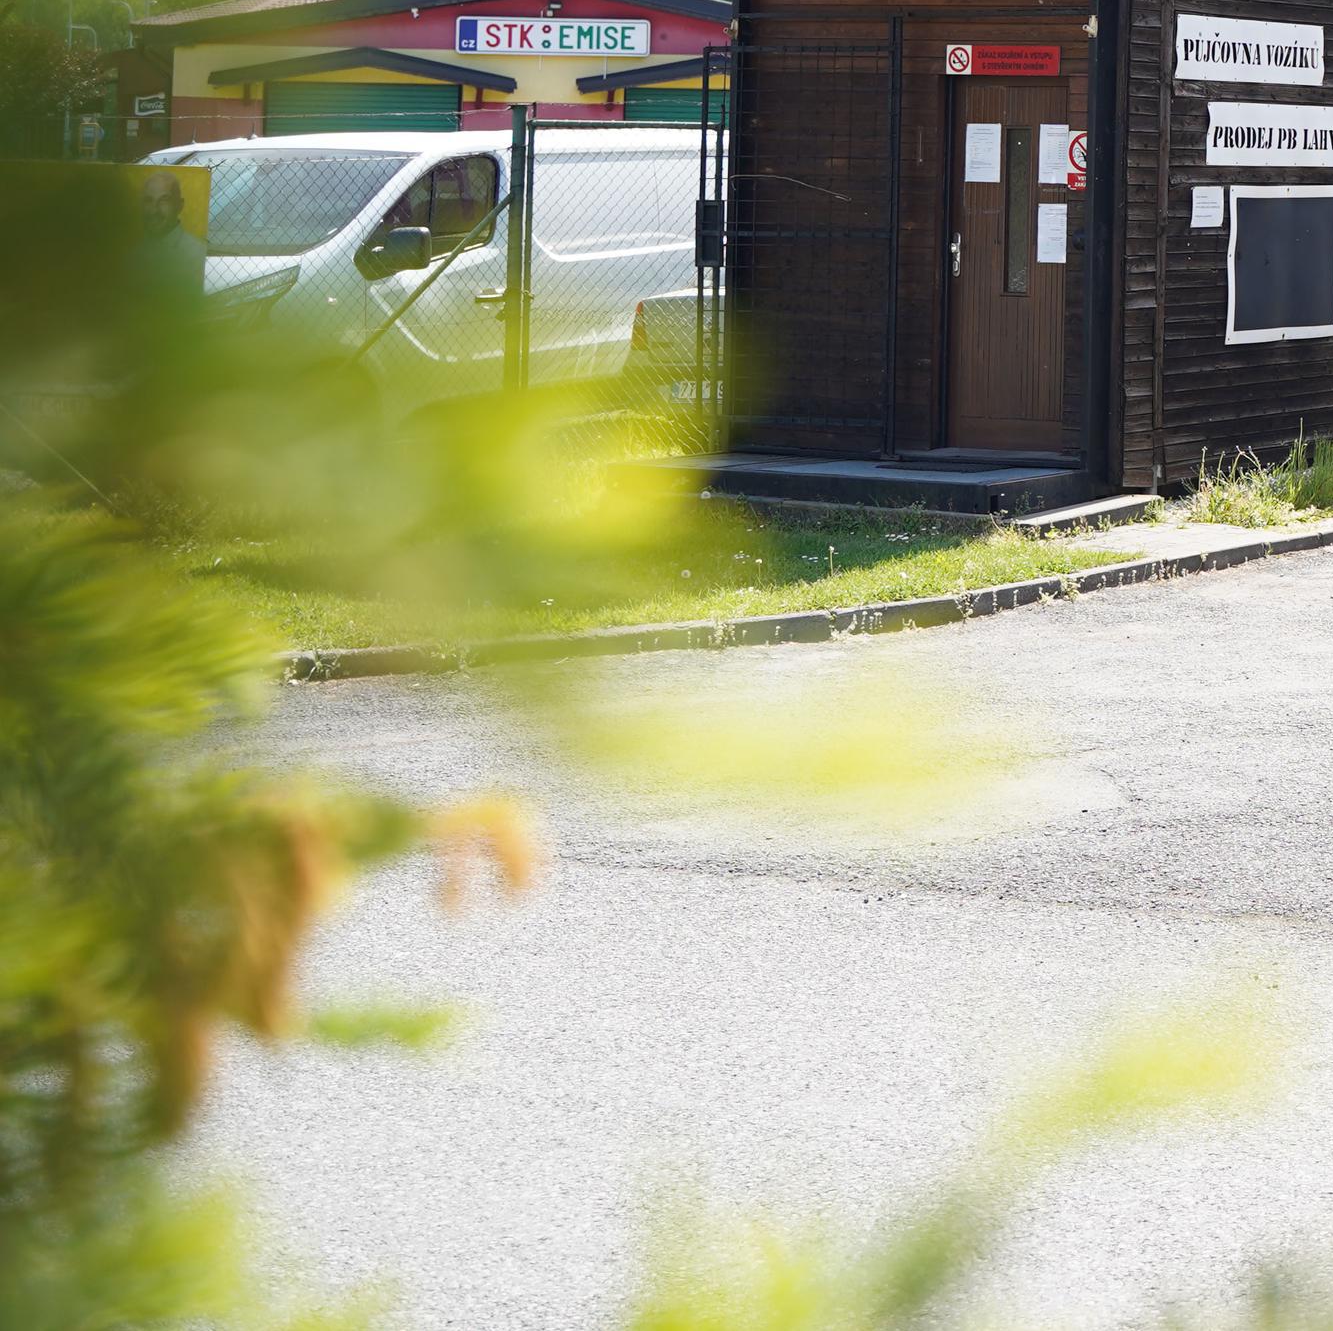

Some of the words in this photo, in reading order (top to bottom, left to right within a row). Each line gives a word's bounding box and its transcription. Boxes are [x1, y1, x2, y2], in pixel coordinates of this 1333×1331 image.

[461, 40, 475, 48] CZ
[485, 23, 534, 49] STK
[559, 25, 636, 50] EMISE
[1183, 32, 1261, 65] PŮJČOVNA
[1212, 125, 1273, 149] PRODEJ
[1277, 127, 1297, 150] PB
